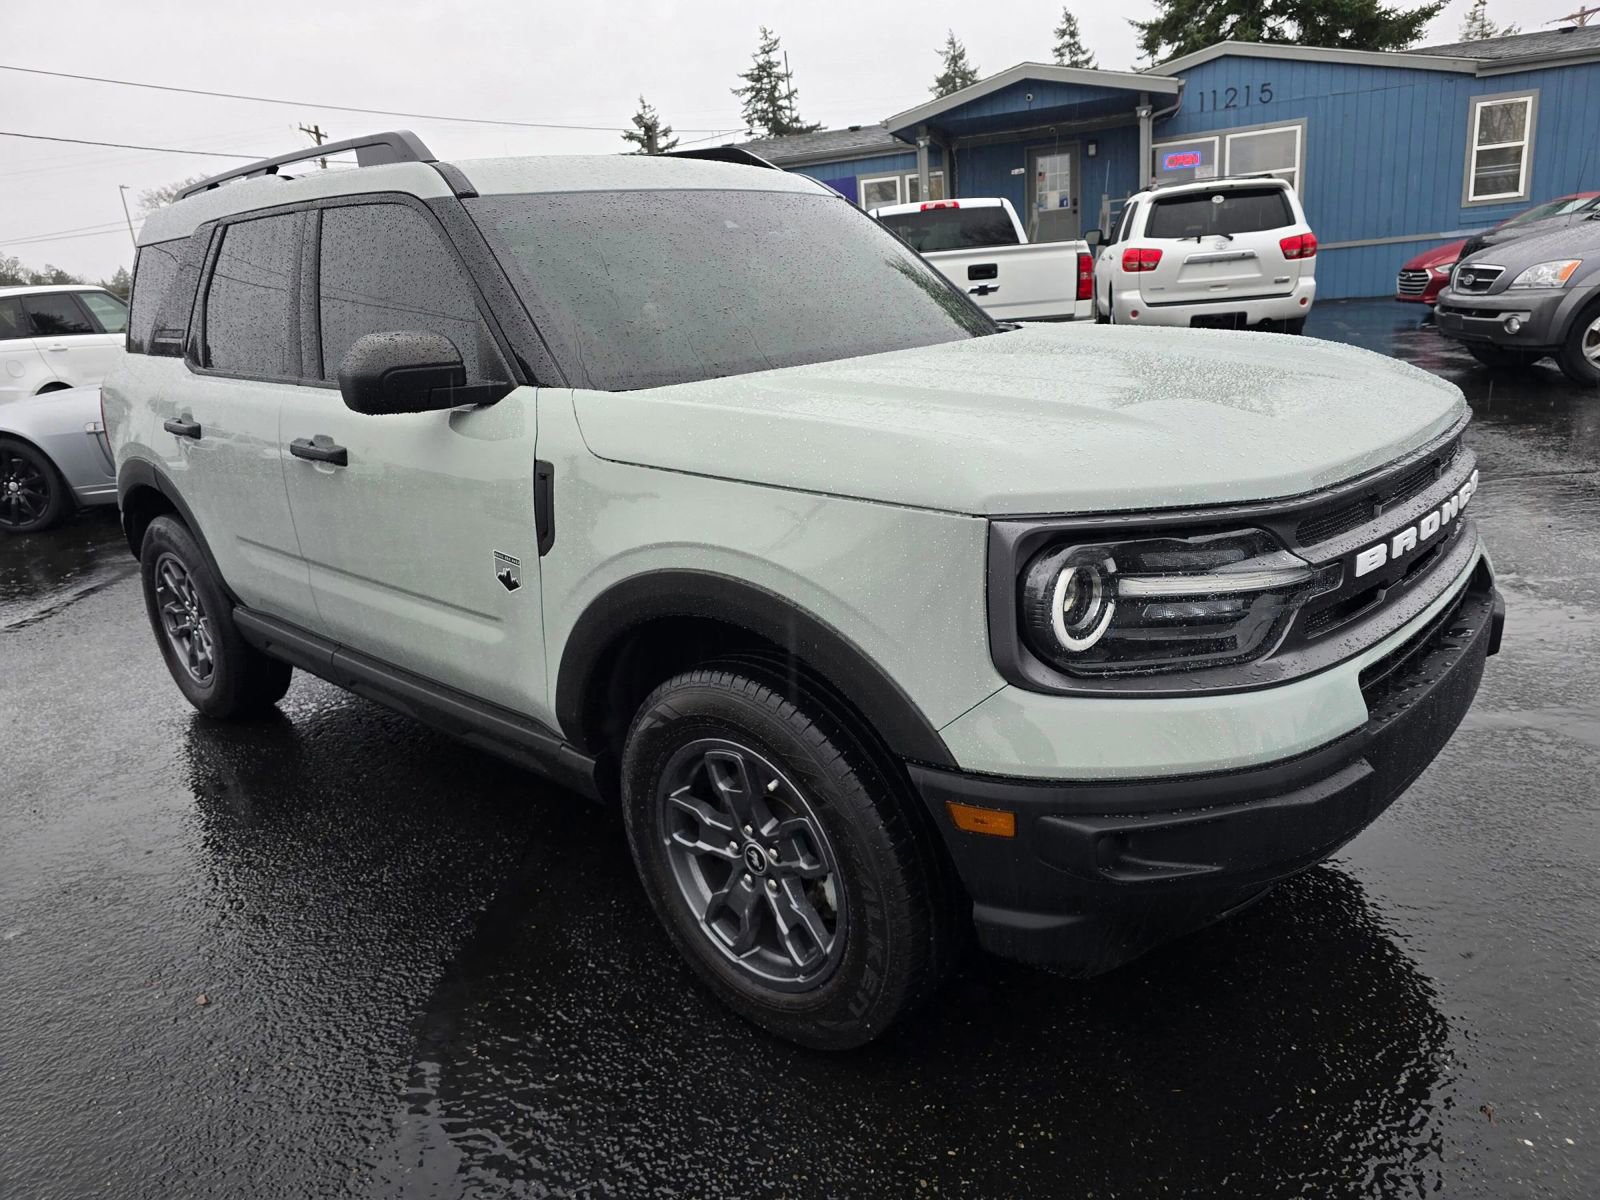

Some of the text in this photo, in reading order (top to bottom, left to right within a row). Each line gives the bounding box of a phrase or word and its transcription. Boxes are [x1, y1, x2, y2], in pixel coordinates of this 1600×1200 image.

[1199, 82, 1273, 112] 11215
[1165, 153, 1200, 168] OPEN
[1355, 469, 1479, 577] BRONCO
